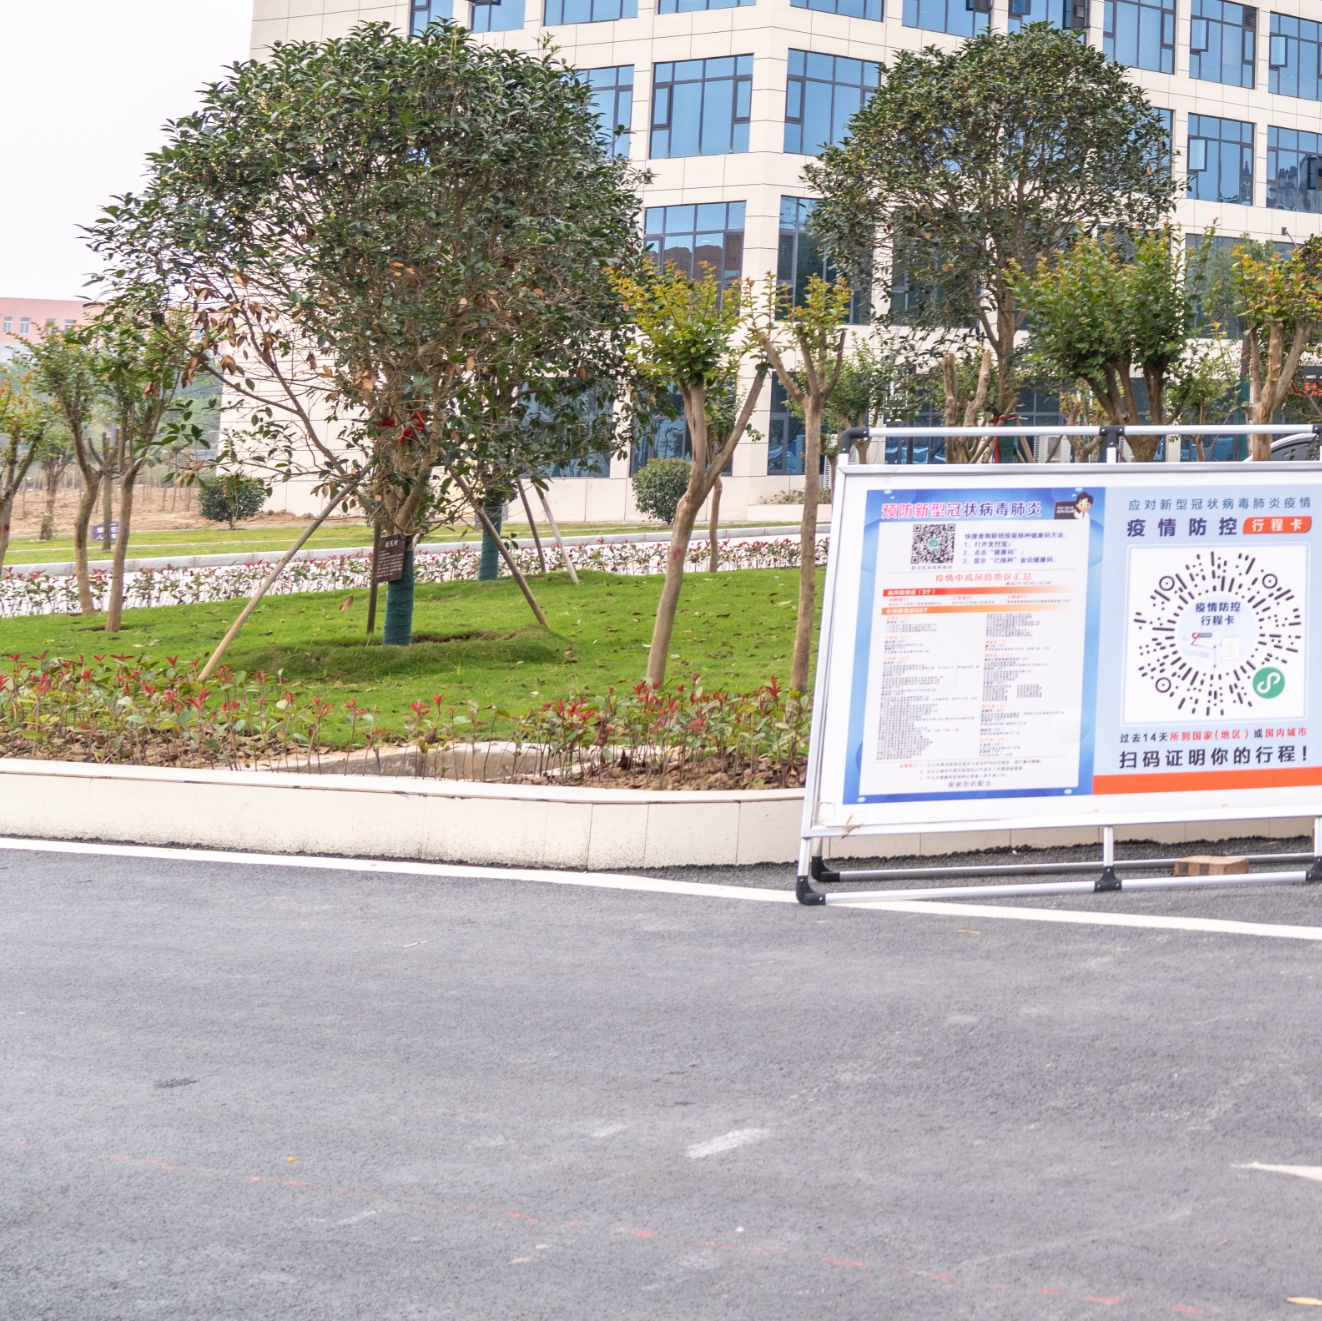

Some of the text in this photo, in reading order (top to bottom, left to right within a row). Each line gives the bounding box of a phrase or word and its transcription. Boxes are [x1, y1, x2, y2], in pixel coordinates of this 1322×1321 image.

[1128, 496, 1311, 511] 应对新型冠状病毒肺炎疫情
[881, 502, 1042, 520] 预防新型冠状病毒肺炎
[1127, 516, 1303, 537] 疫情防控 行程卡
[935, 572, 1032, 583] 疫情中高风险地区汇总
[1195, 601, 1241, 613] 疫情防控
[1200, 615, 1235, 626] 行程卡
